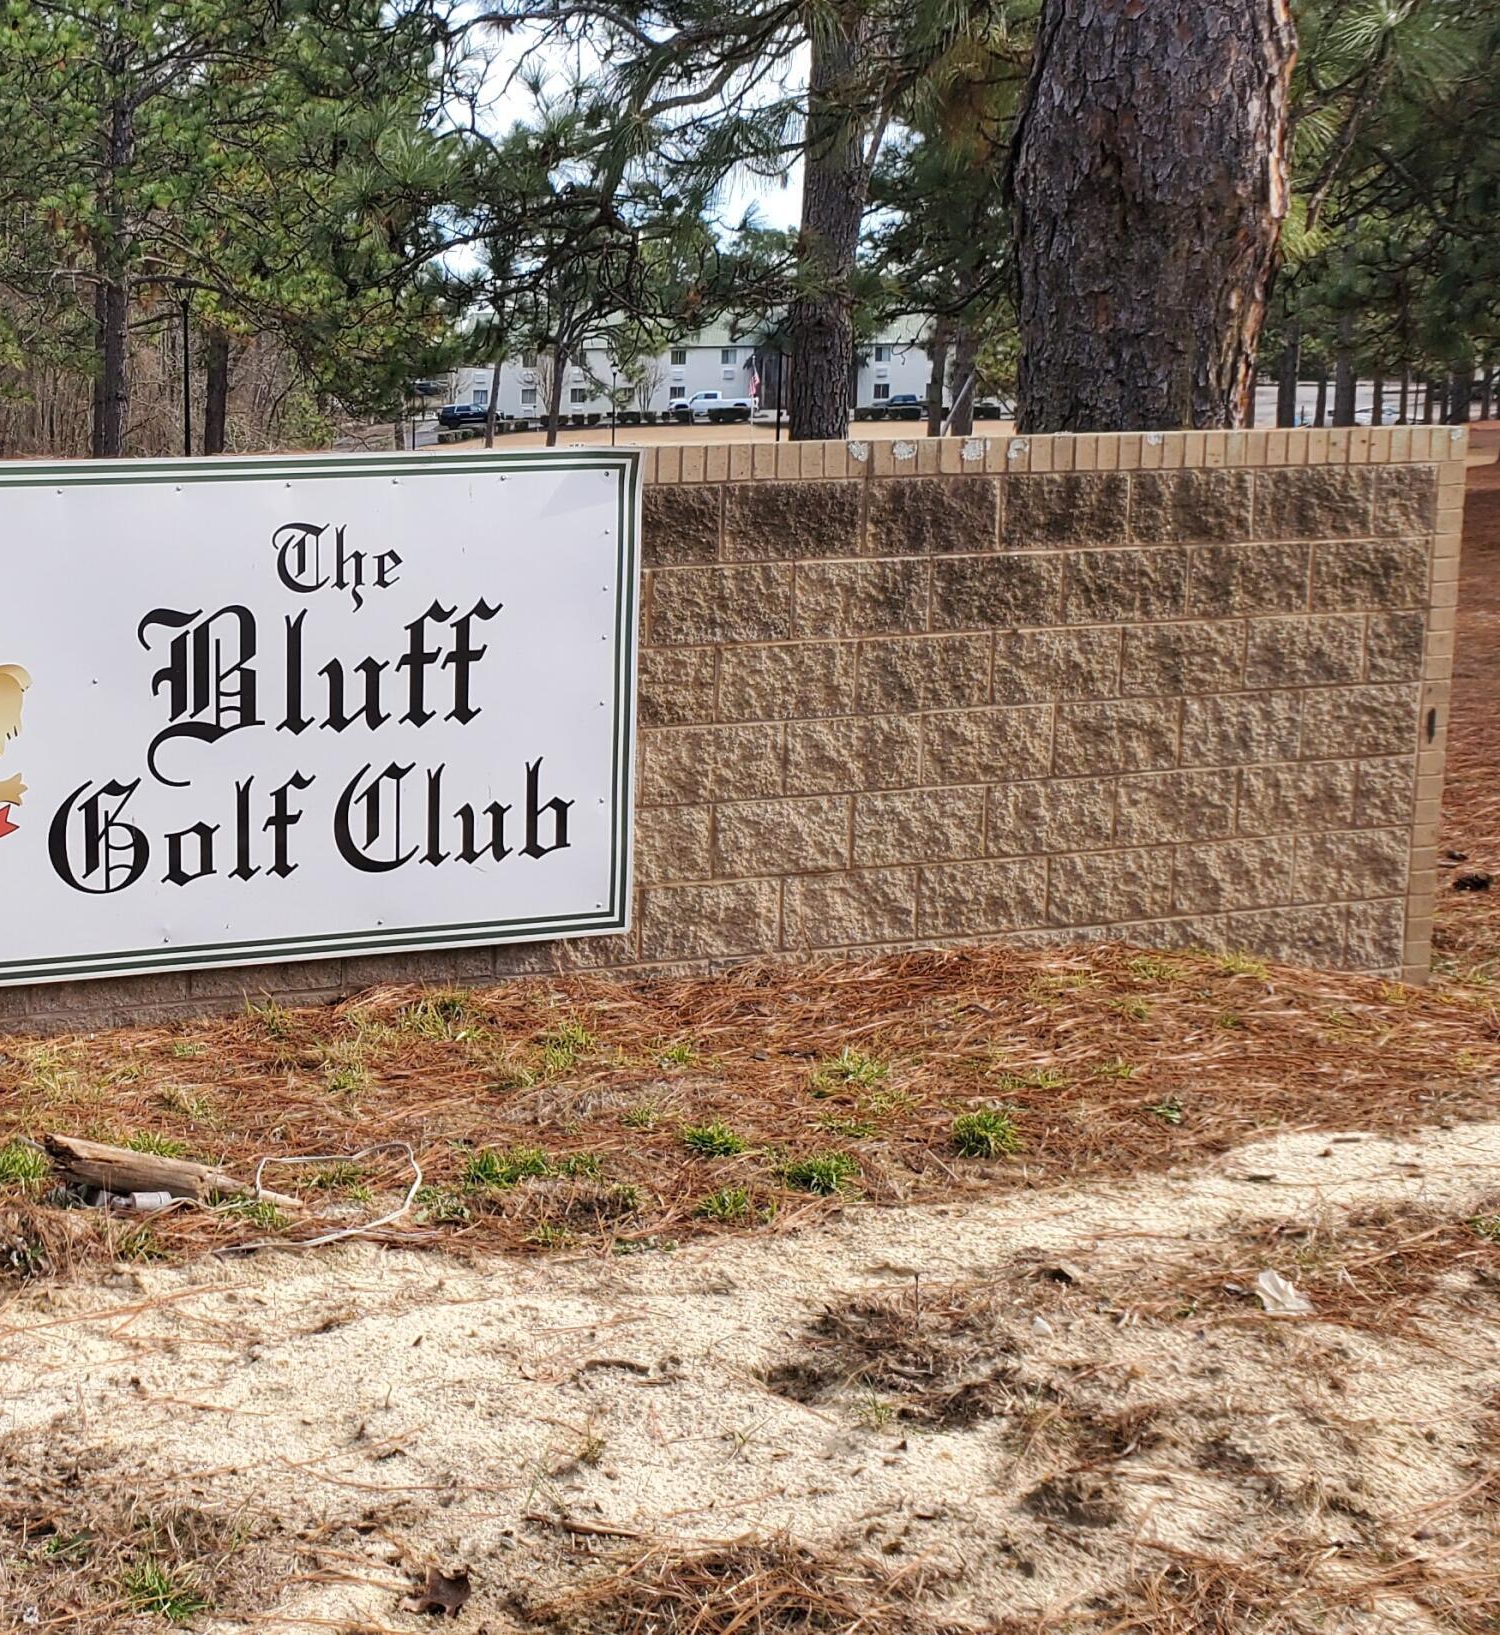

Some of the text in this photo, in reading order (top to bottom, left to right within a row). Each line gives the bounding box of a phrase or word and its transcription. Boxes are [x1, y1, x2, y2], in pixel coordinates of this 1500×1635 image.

[272, 522, 403, 613] The
[137, 598, 503, 787] Bluff
[47, 756, 575, 895] Golf Club
